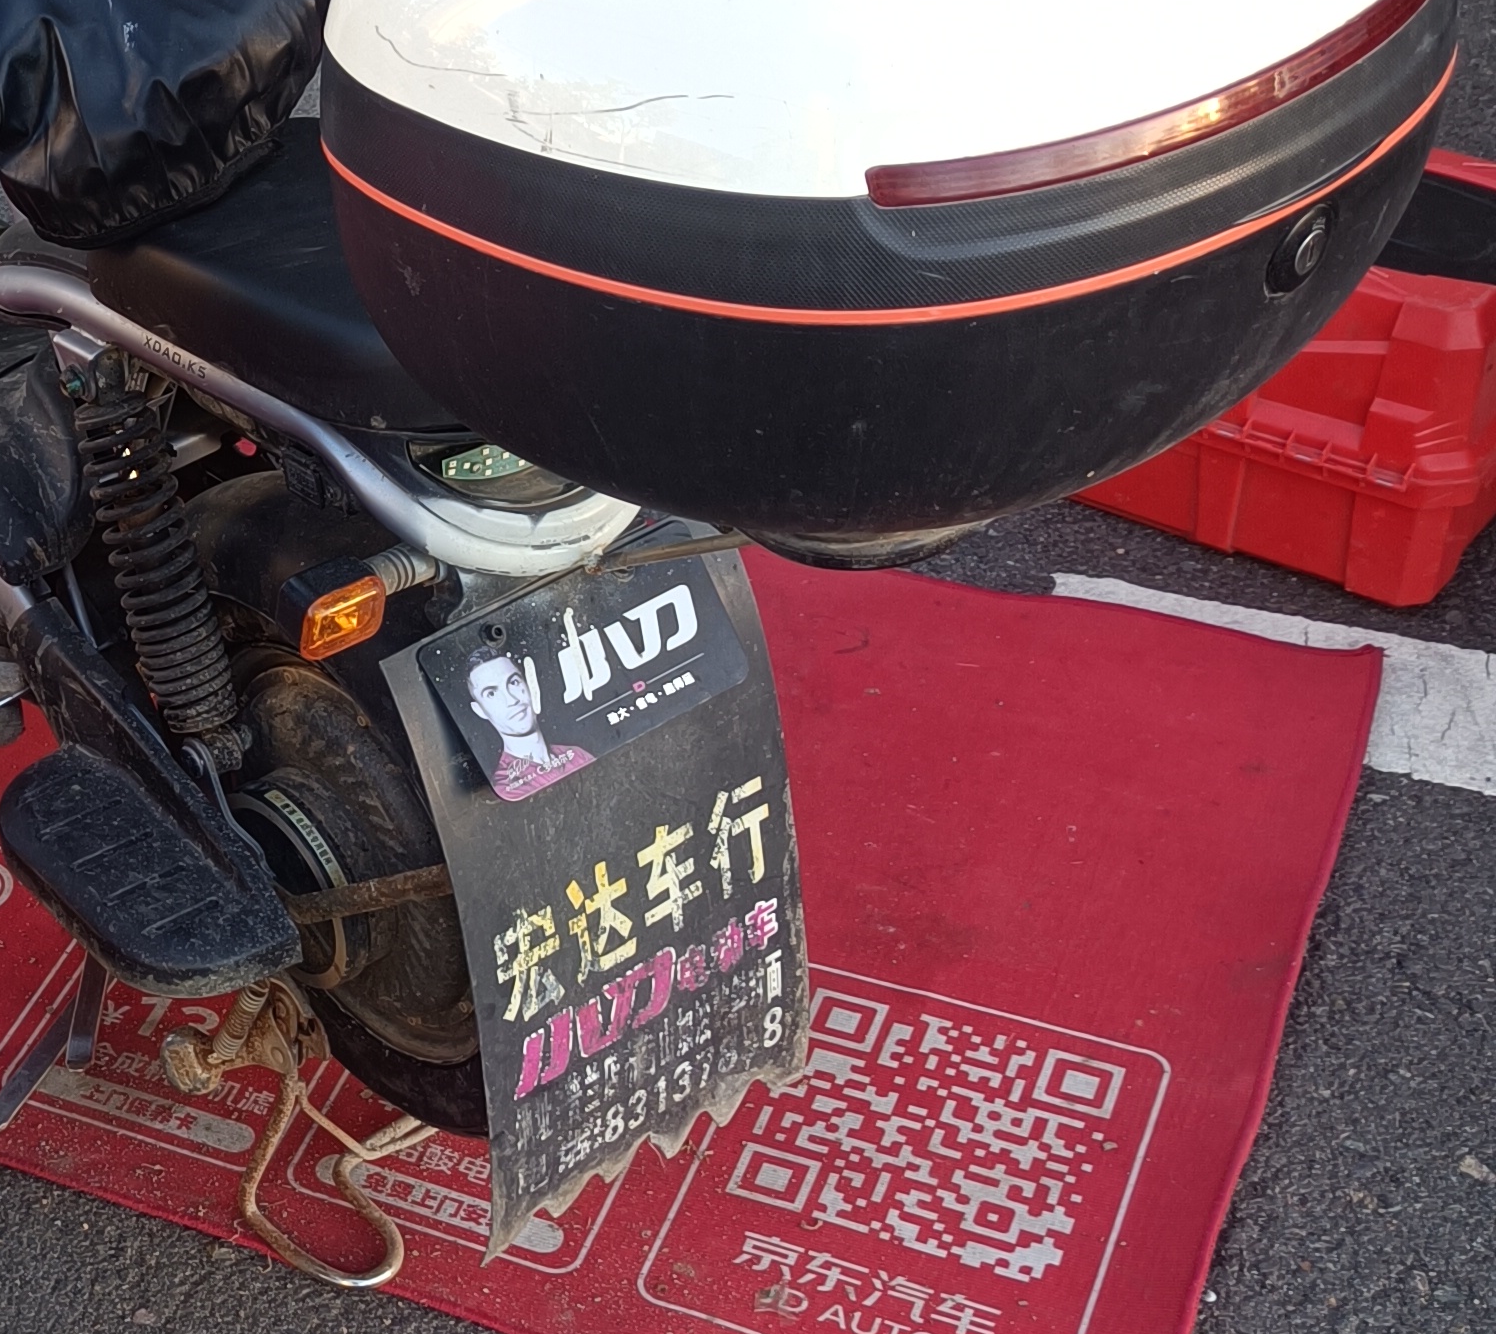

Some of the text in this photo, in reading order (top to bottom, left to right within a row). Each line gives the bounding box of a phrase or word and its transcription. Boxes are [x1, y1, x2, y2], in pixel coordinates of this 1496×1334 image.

[493, 775, 770, 1021] 宏达车行
[363, 1171, 492, 1228] 免费上门安
